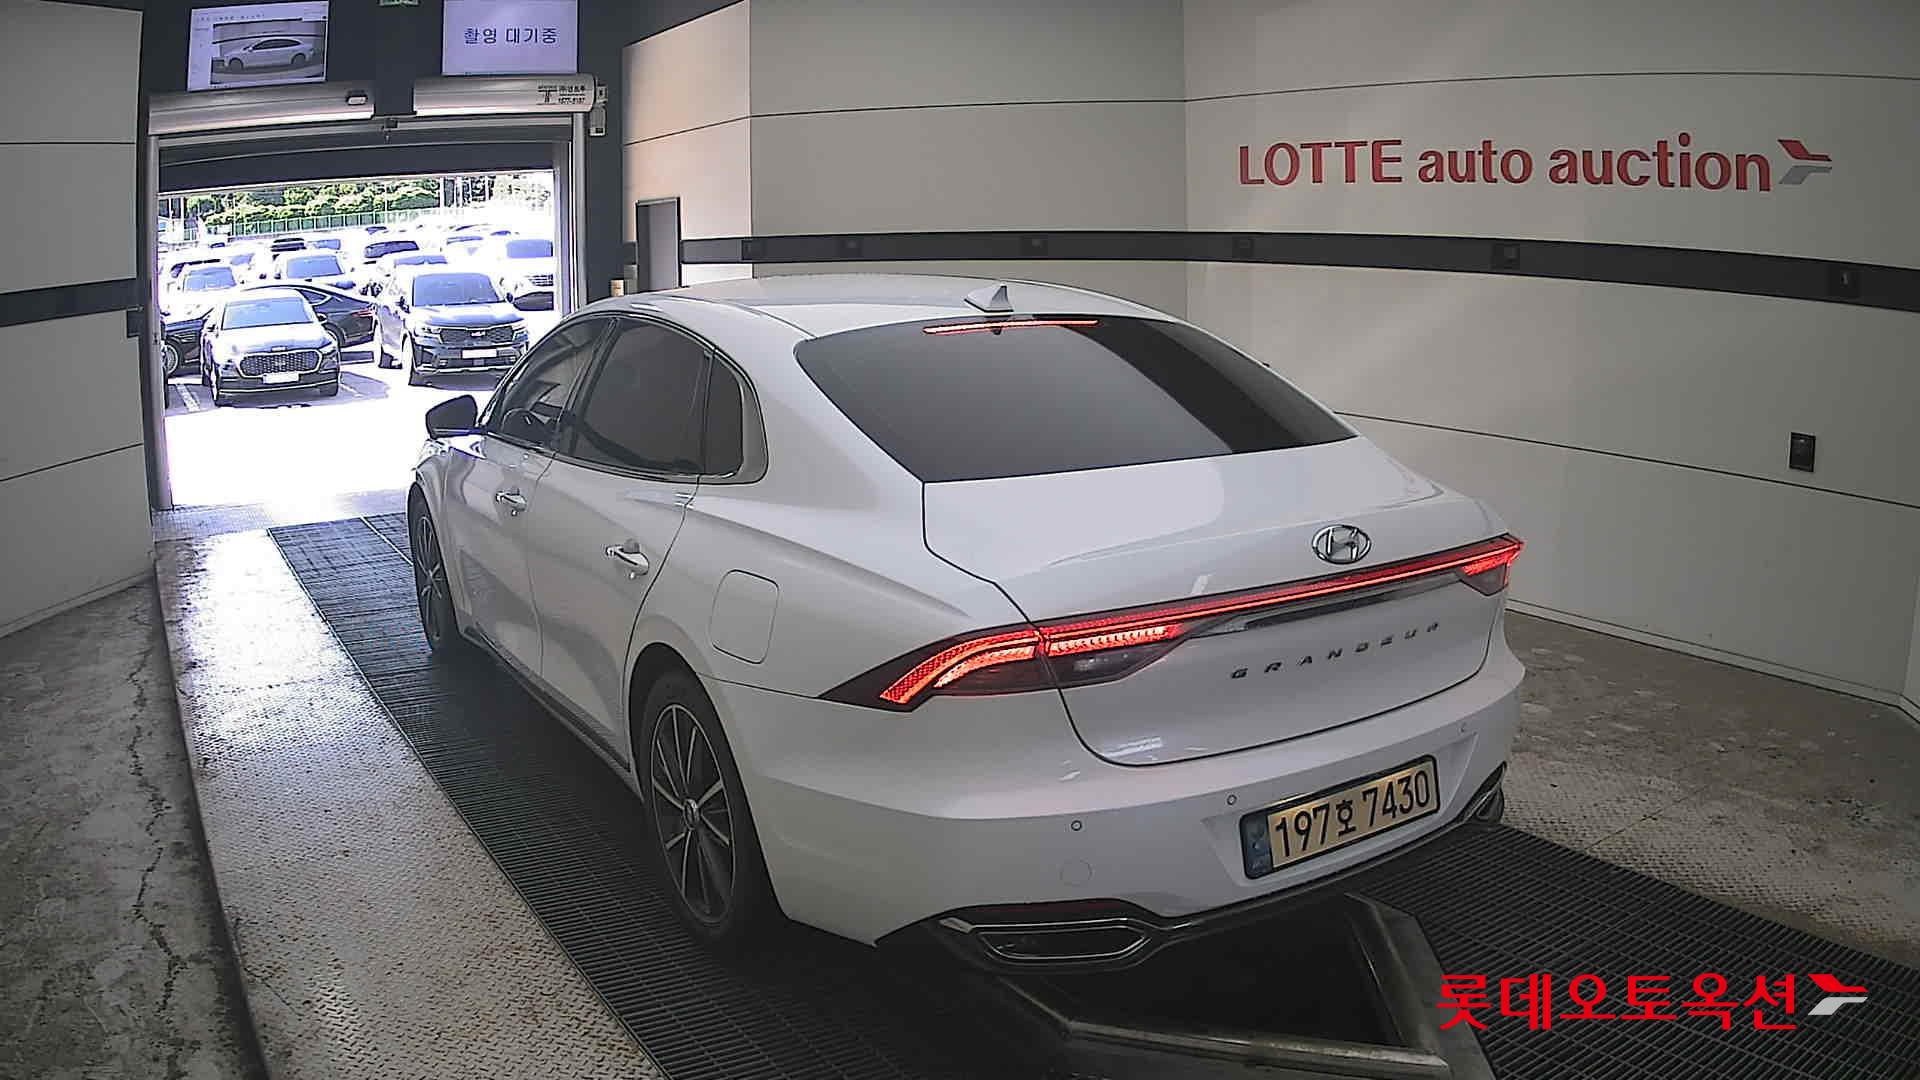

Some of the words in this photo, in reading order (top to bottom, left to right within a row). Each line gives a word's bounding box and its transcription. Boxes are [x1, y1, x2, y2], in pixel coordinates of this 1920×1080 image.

[464, 27, 497, 45] 촬영
[505, 27, 557, 45] 대기중
[1238, 139, 1402, 186] LOTTE
[1416, 139, 1533, 185] auto
[1548, 132, 1771, 192] auction
[1230, 622, 1439, 680] GRANDEUR
[1275, 799, 1357, 858] 197호
[1362, 770, 1430, 828] 7430
